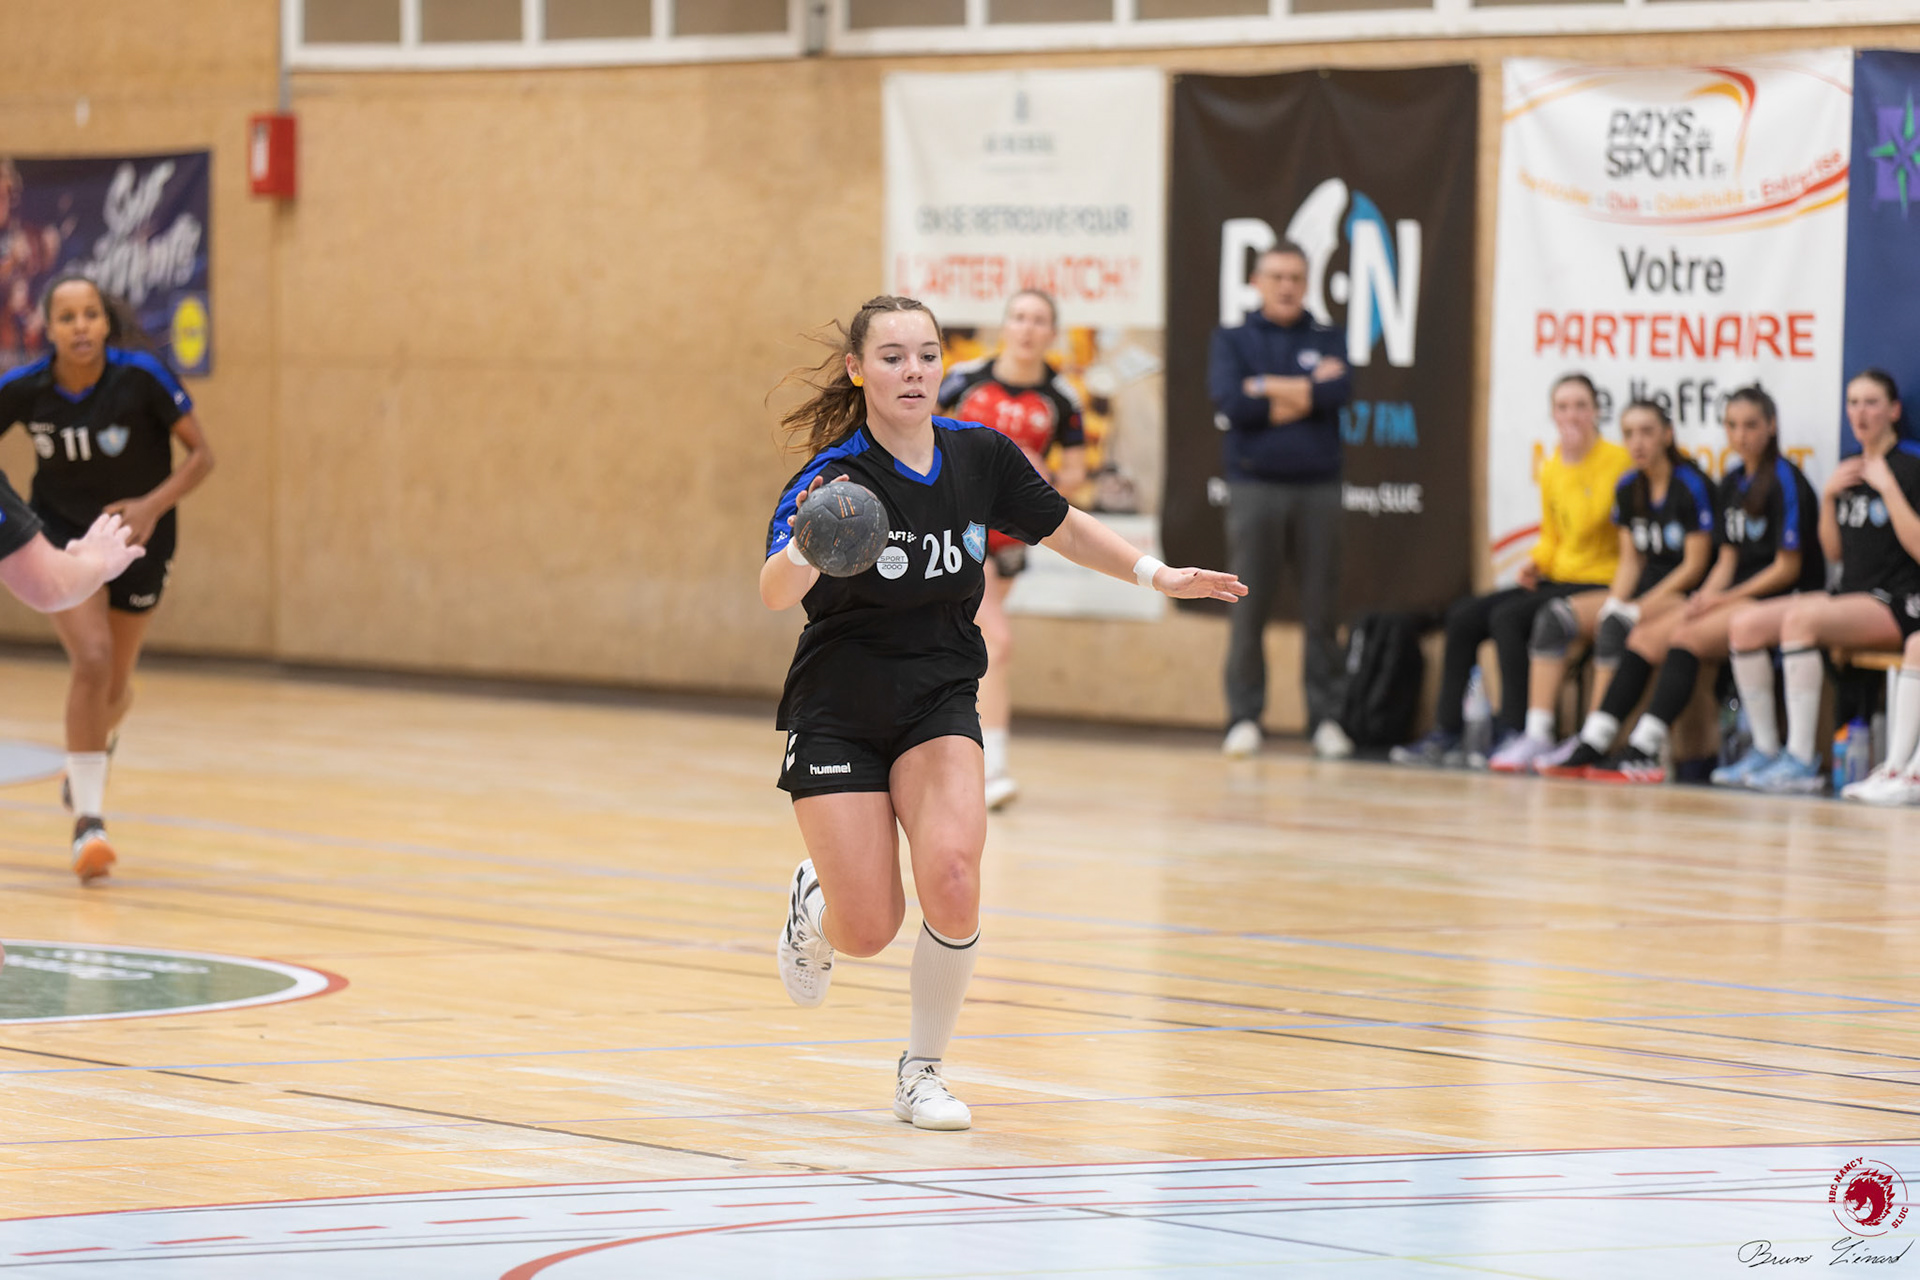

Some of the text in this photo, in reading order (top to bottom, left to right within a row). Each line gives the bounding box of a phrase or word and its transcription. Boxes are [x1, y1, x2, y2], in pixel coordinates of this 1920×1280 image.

[1610, 107, 1695, 141] PAYS
[1607, 146, 1712, 178] SPORT
[1618, 246, 1726, 296] Votre
[1534, 312, 1816, 360] PARTENAIRE
[60, 426, 92, 462] 11
[888, 530, 907, 541] AFT
[922, 529, 963, 580] 26
[809, 762, 852, 775] hummel
